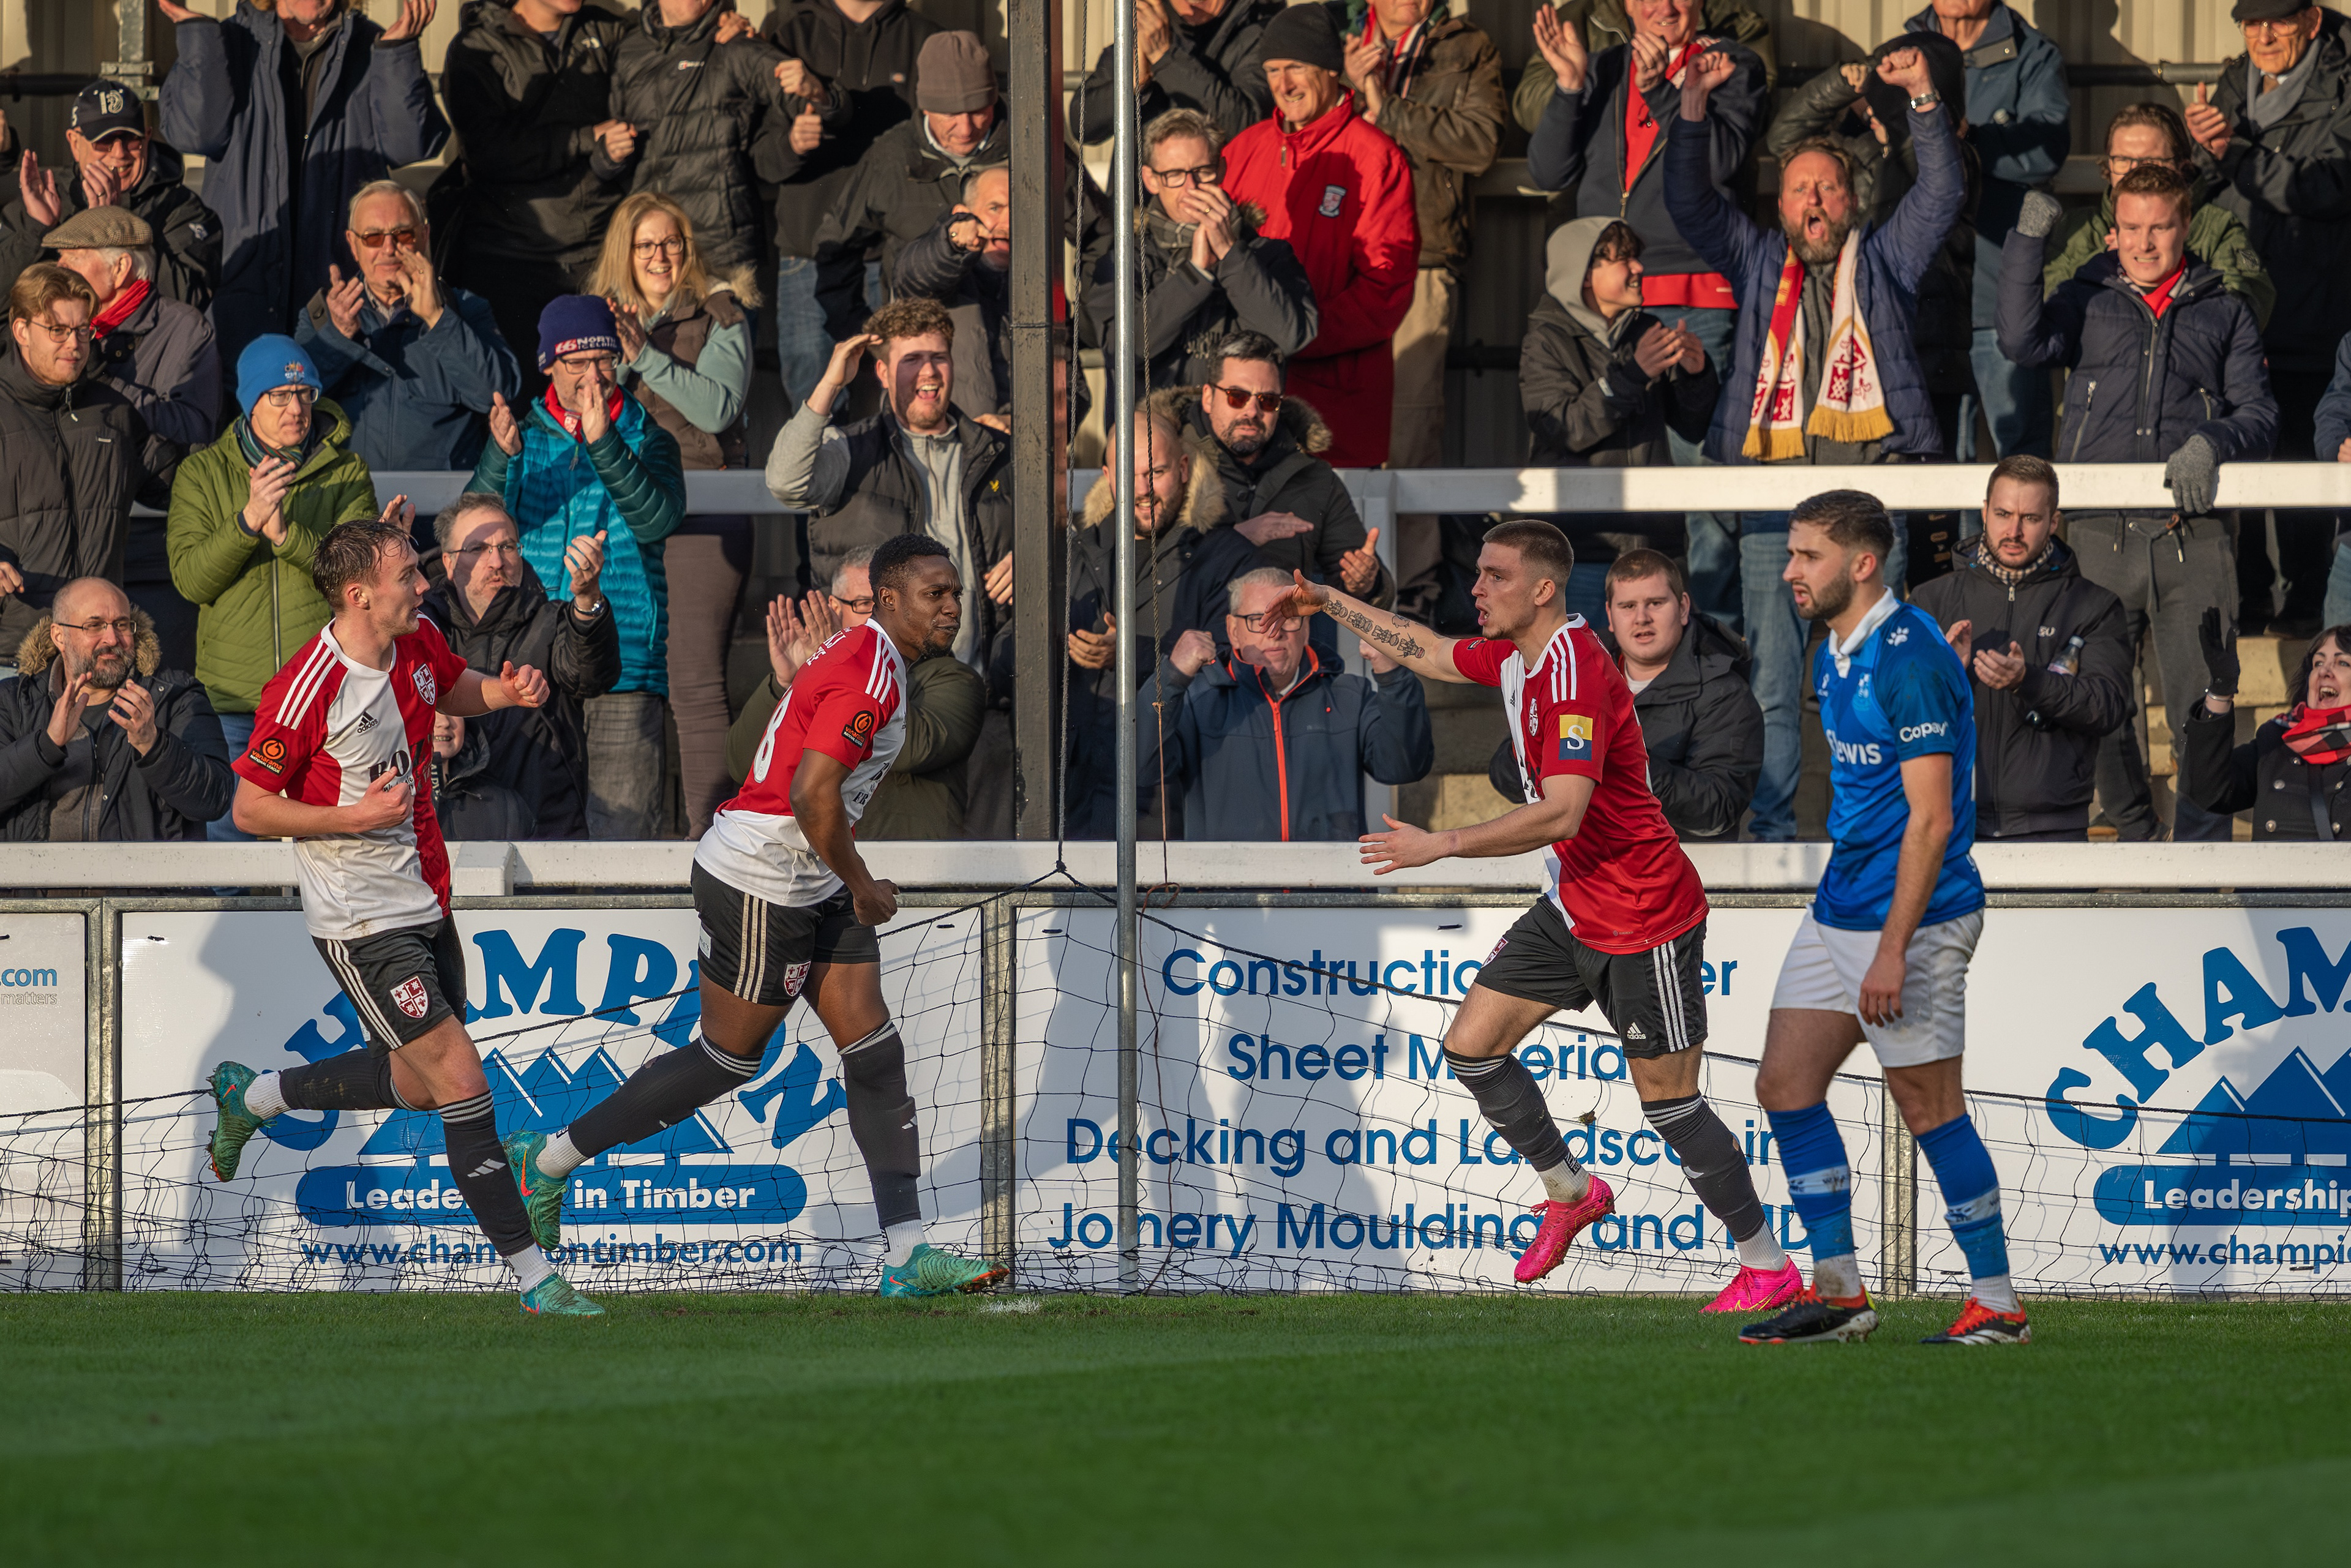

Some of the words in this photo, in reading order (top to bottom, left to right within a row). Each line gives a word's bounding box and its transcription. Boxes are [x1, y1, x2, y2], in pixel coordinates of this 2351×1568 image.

[358, 719, 378, 733] adidas
[1567, 725, 1584, 749] S
[250, 754, 266, 767] NATIONAL
[266, 764, 280, 773] LEAGUE
[252, 751, 282, 770] vanarama
[0, 969, 57, 986] com
[1163, 949, 1482, 996] Constructio
[1, 991, 58, 1005] matters
[1228, 1034, 1388, 1080] Sheet
[1325, 1119, 1437, 1165] and
[574, 1179, 607, 1209] in
[621, 1178, 756, 1209] Timber
[1047, 1203, 1257, 1258] Jonery
[1277, 1203, 1545, 1261] Moulding
[1592, 1204, 1703, 1250] and
[2098, 1234, 2351, 1274] www.champi
